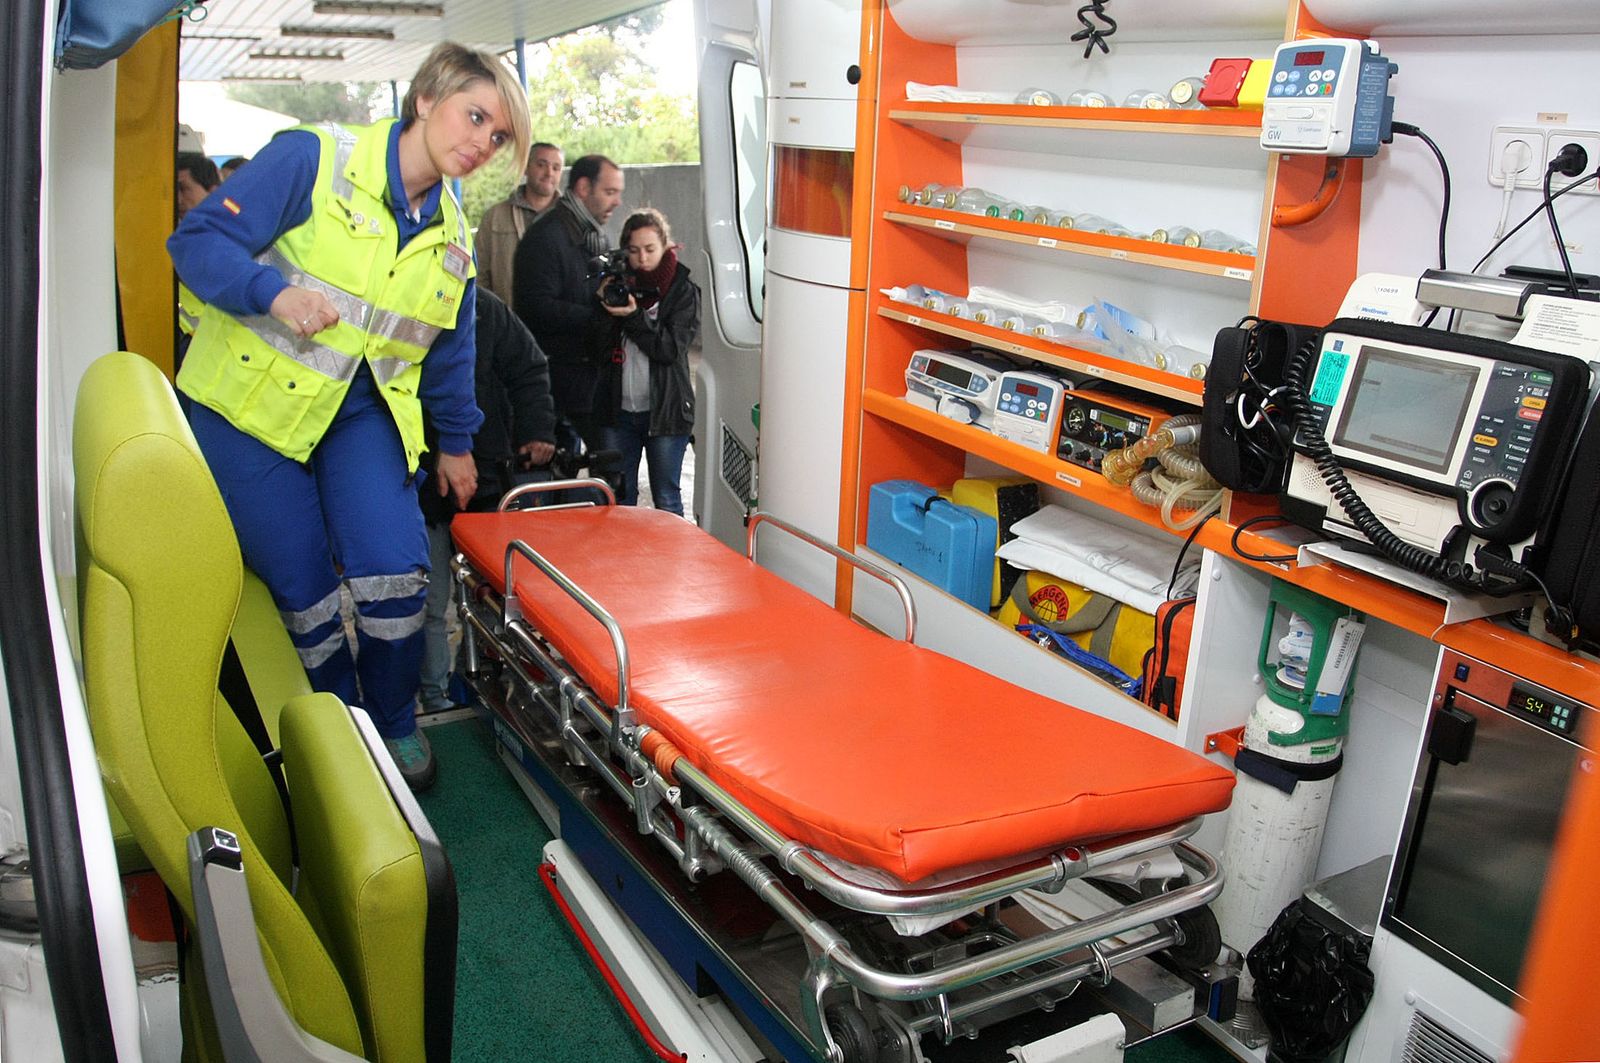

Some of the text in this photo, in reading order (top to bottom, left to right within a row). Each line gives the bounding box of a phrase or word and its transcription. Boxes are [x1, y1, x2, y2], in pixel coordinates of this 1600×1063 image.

[1267, 130, 1282, 140] GW
[1517, 385, 1524, 393] 2
[1513, 396, 1520, 404] 3
[1029, 587, 1068, 619] MERGENCY
